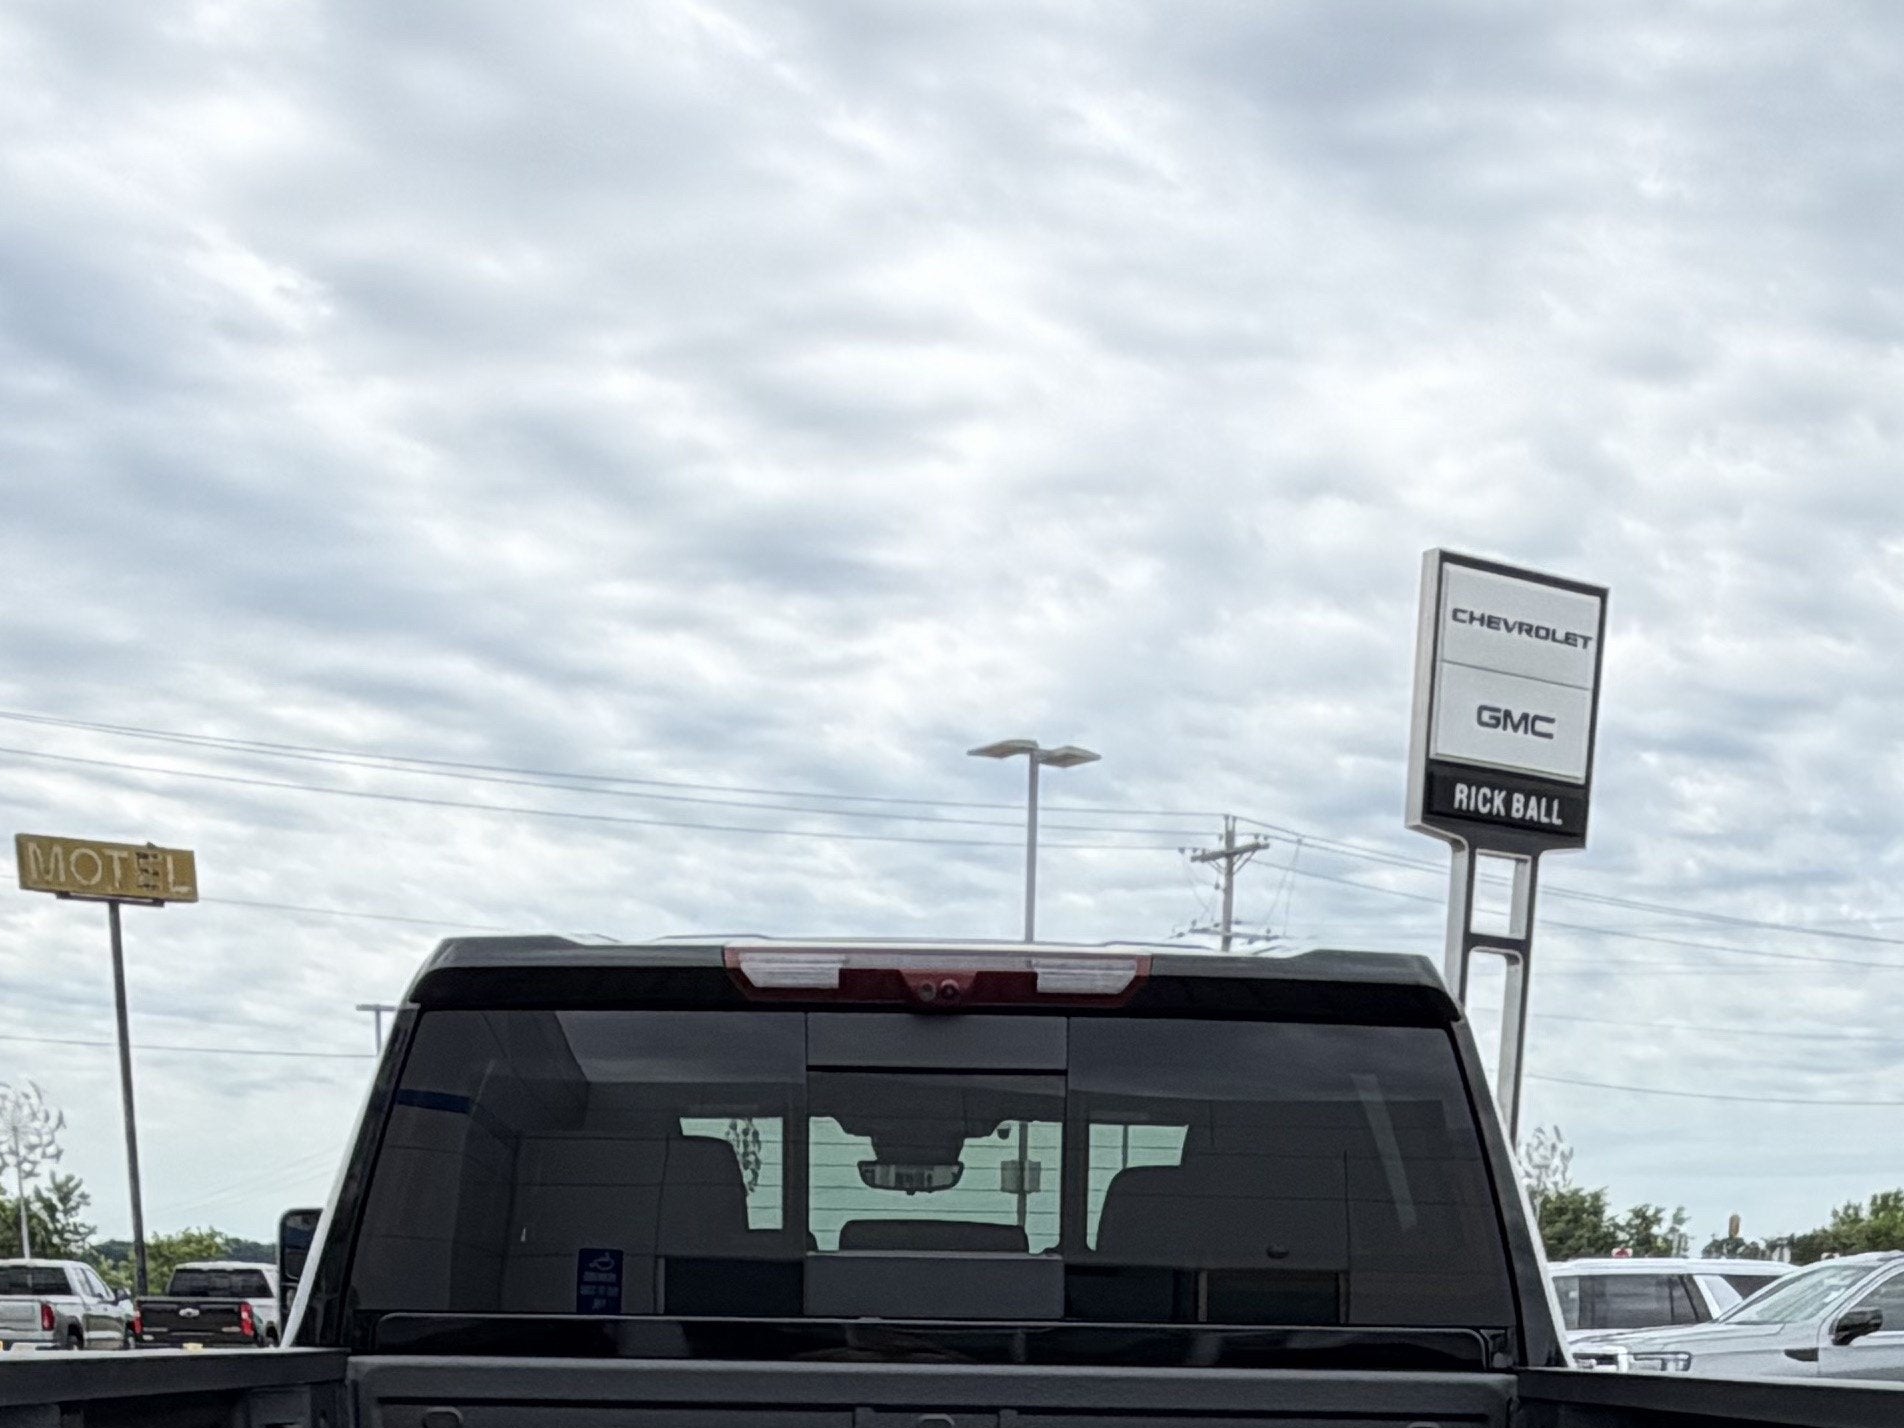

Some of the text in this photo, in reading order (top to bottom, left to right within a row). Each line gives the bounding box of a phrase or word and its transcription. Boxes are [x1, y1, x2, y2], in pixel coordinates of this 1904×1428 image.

[1451, 607, 1594, 650] CHEVROLET
[1476, 704, 1556, 740] GMC
[1453, 782, 1564, 826] RICK BALL
[26, 841, 193, 894] MOTEL
